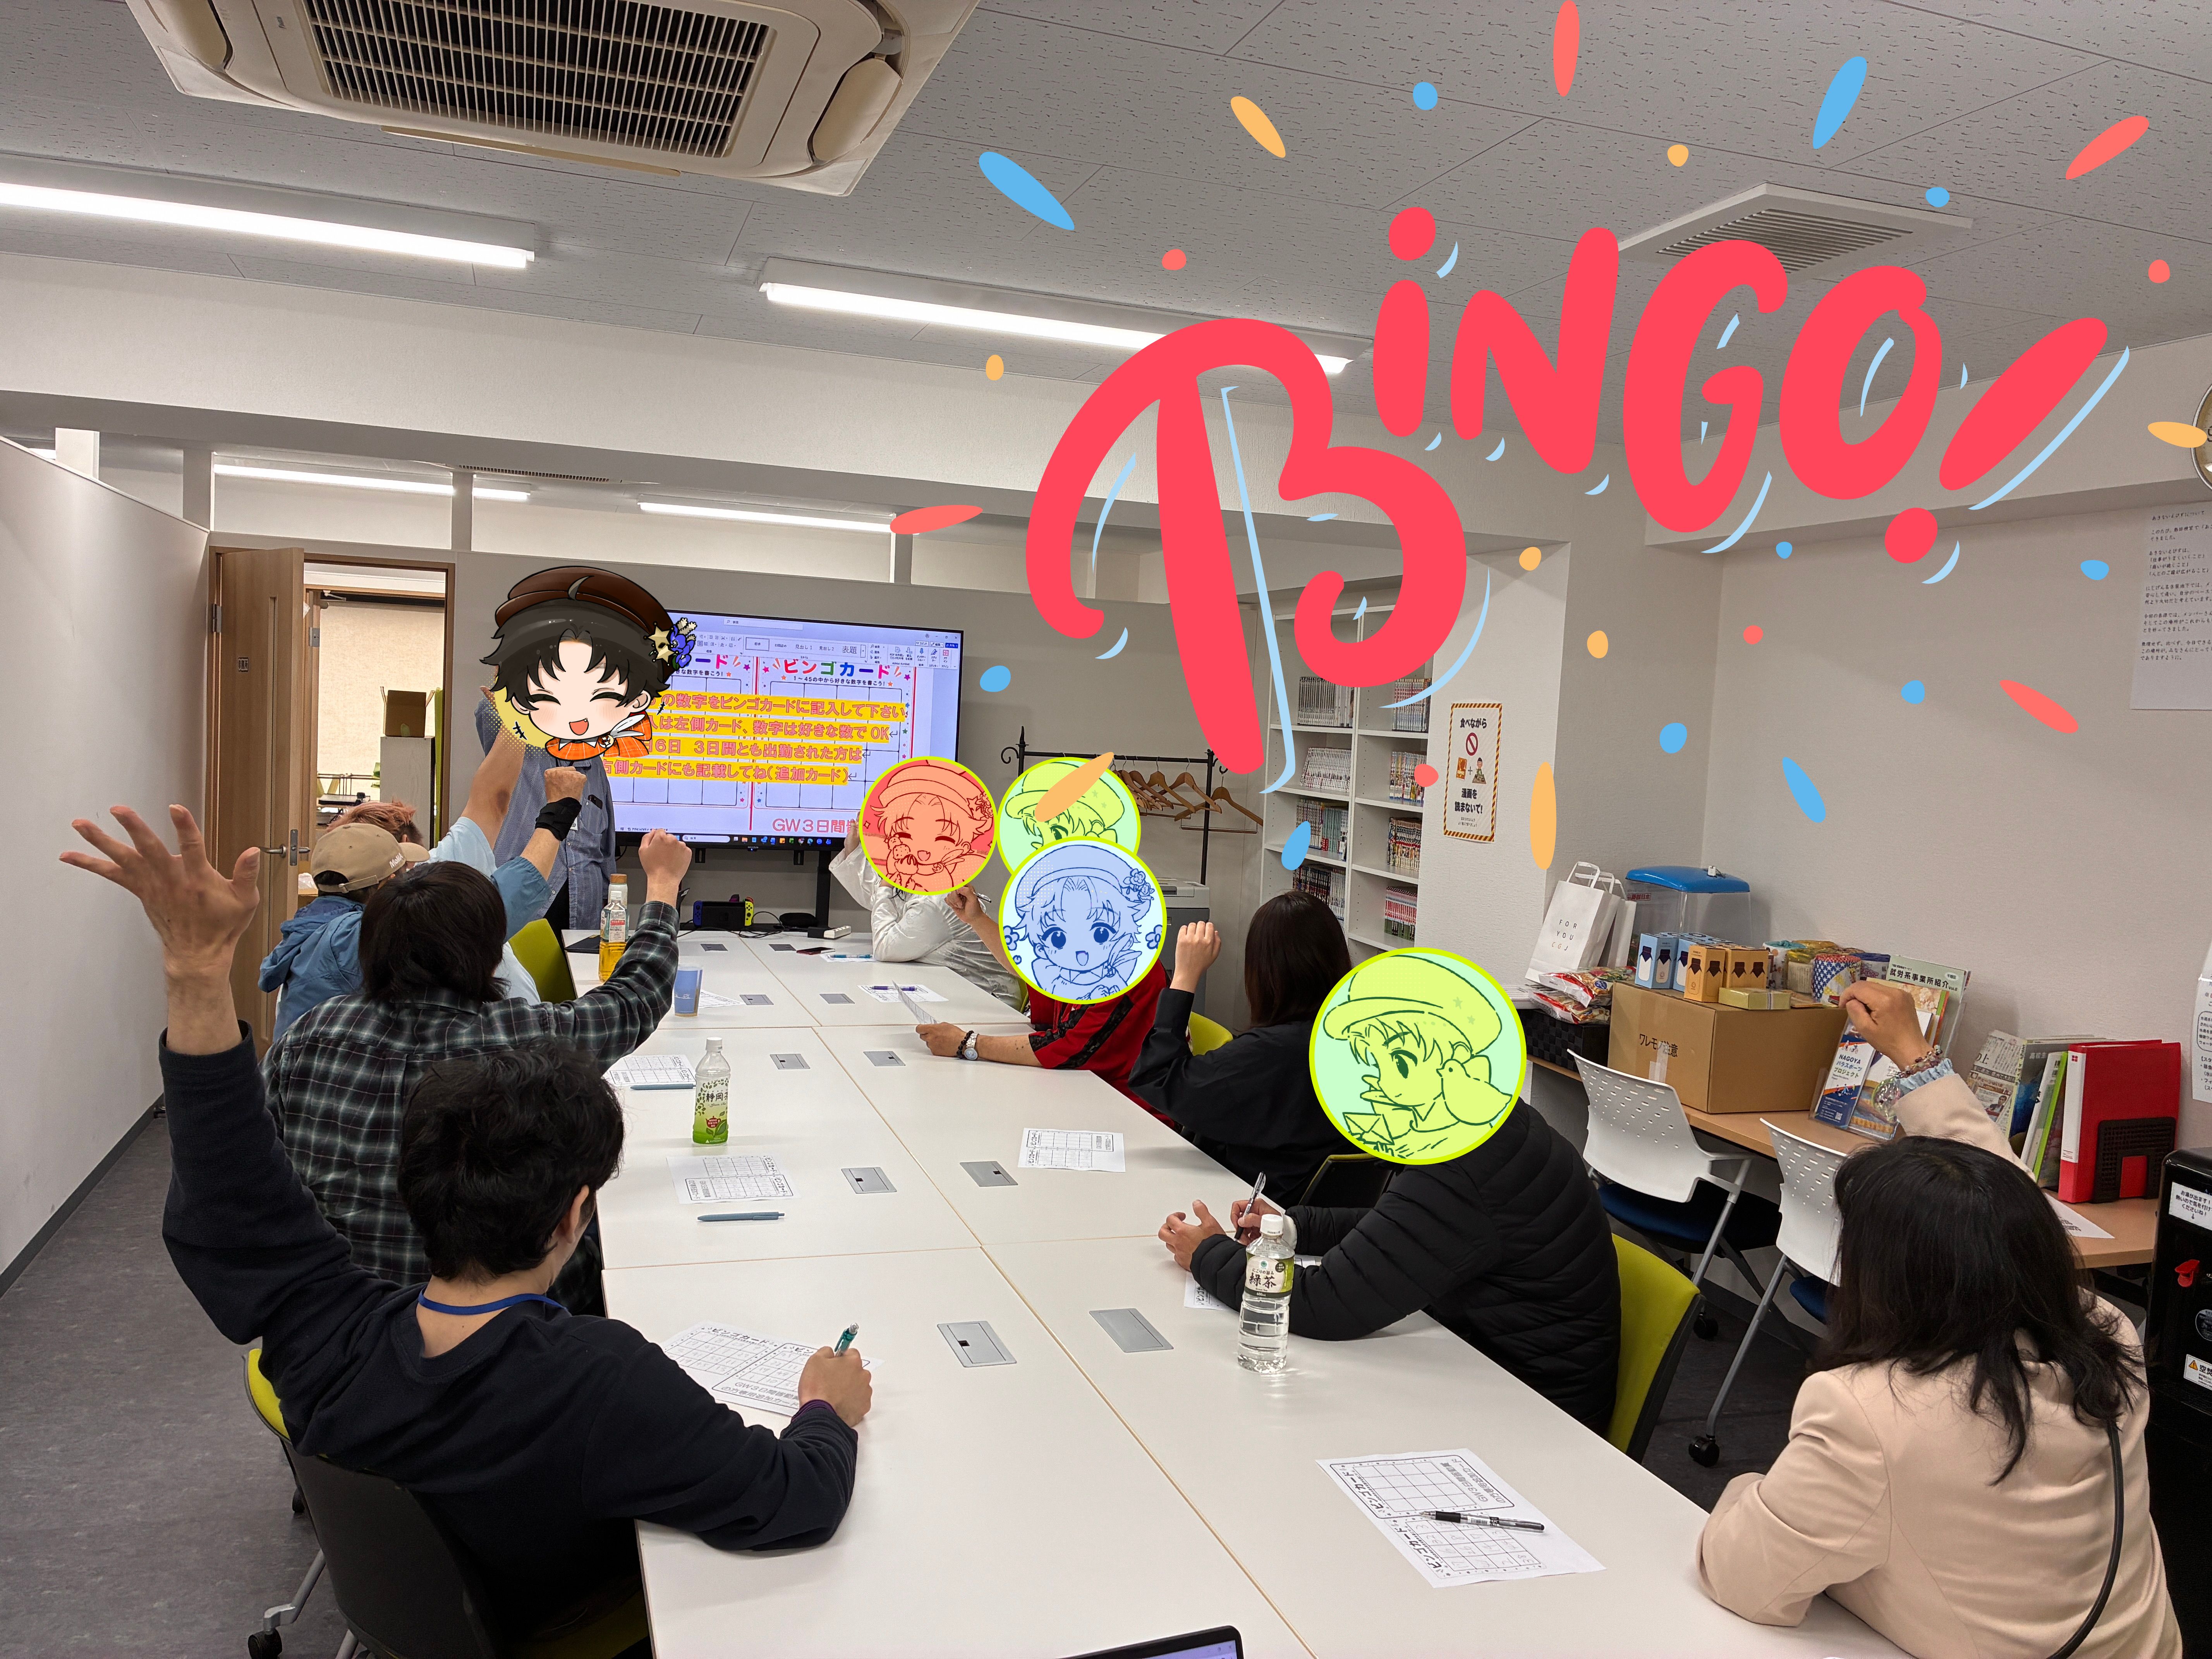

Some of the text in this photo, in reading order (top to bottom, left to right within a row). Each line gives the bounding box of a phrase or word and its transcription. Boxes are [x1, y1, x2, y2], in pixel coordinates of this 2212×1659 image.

[842, 646, 857, 654] 表題
[784, 658, 890, 679] ビンゴカード
[1460, 718, 1487, 729] 食べながら
[871, 726, 890, 740] OK
[694, 740, 862, 761] 3日間とも出勤された方は
[1461, 788, 1477, 799] 漫画を
[1559, 919, 1577, 929] FOR
[1557, 930, 1574, 940] YOU
[1889, 968, 1949, 989] 就労系事業所紹介
[1836, 1061, 1862, 1072] パラスポーツ
[1839, 1054, 1861, 1065] NAGOYA
[1834, 1067, 1859, 1079] プロジェクト
[2176, 1195, 2212, 1212] 熱いので気を付け
[1249, 1273, 1277, 1289] 緑茶
[712, 1328, 769, 1344] ビンゴカード
[1342, 1472, 1384, 1509] ビンゴカード
[1394, 1528, 1442, 1568] ビンゴカード
